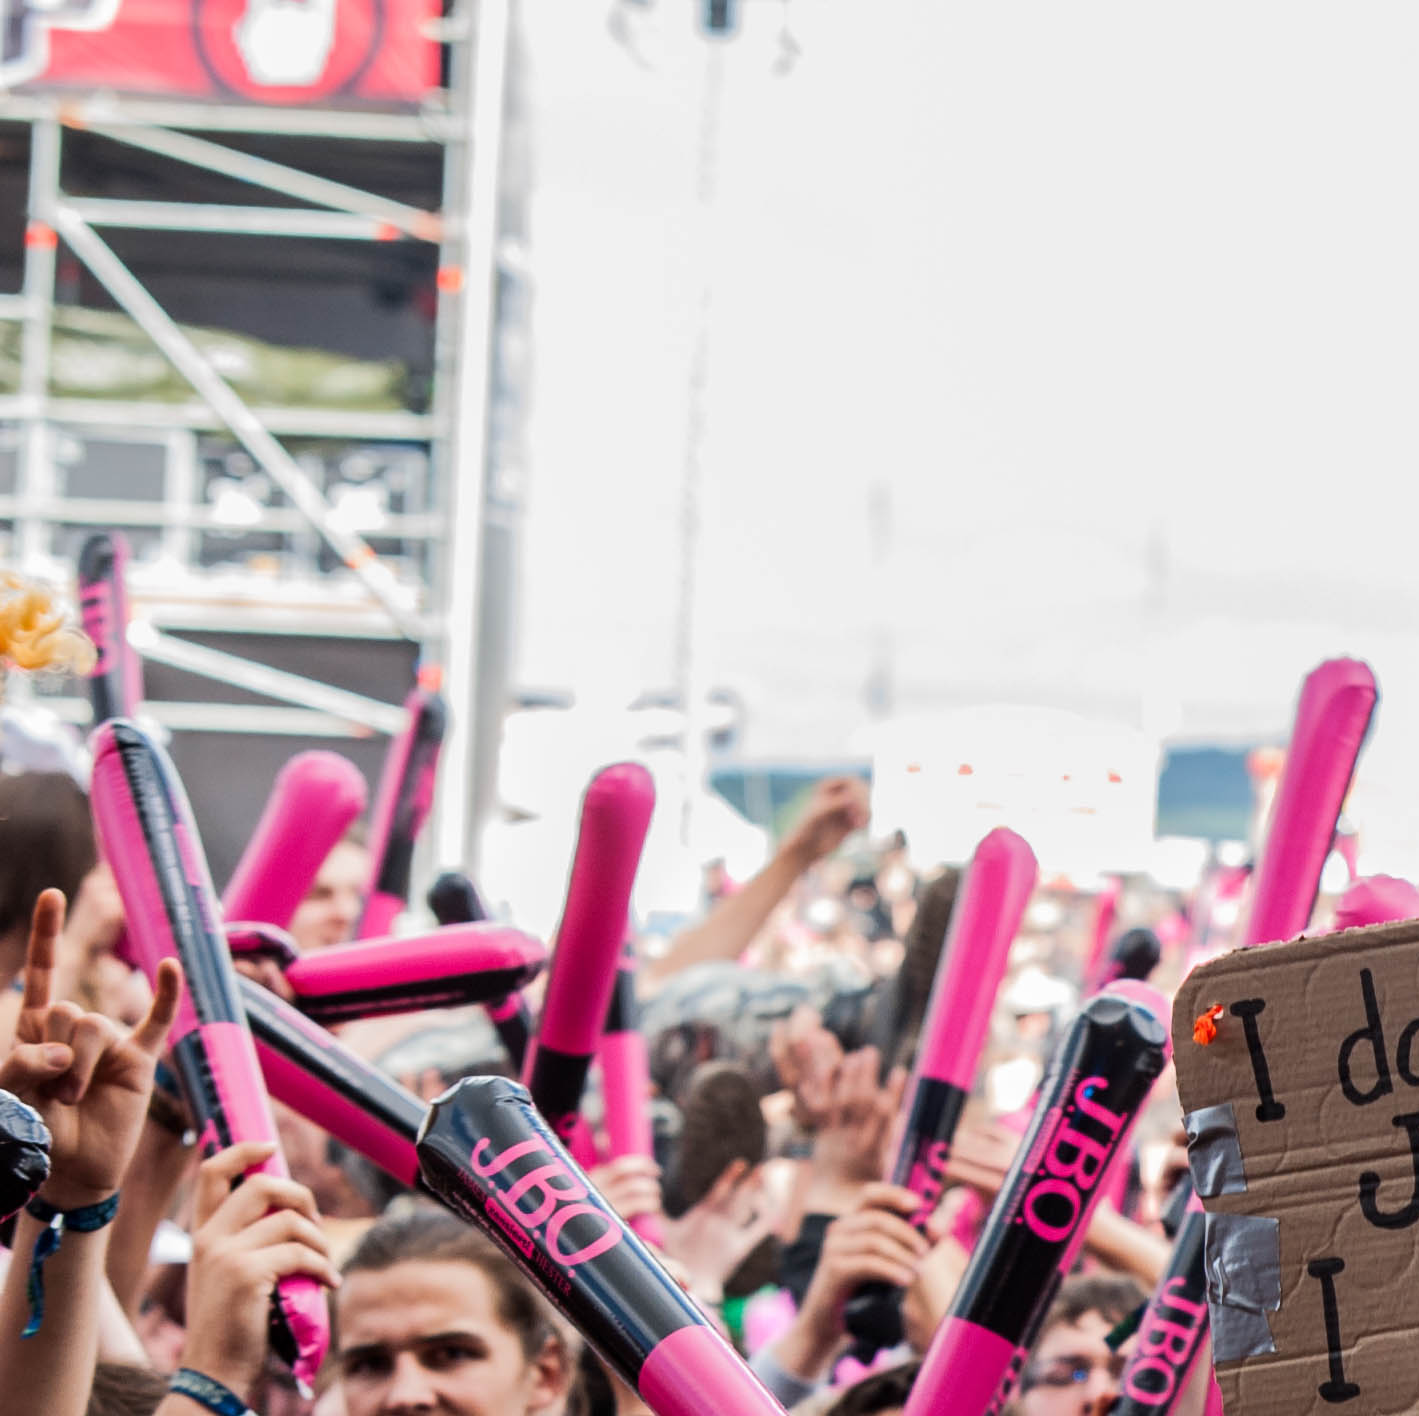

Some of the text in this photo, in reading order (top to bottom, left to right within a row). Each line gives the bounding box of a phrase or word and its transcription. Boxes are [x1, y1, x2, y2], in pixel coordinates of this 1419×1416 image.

[1230, 999, 1285, 1122] I
[471, 1132, 624, 1278] J.B.O.
[1015, 1076, 1128, 1243] J.B.O.
[1307, 1257, 1361, 1401] I
